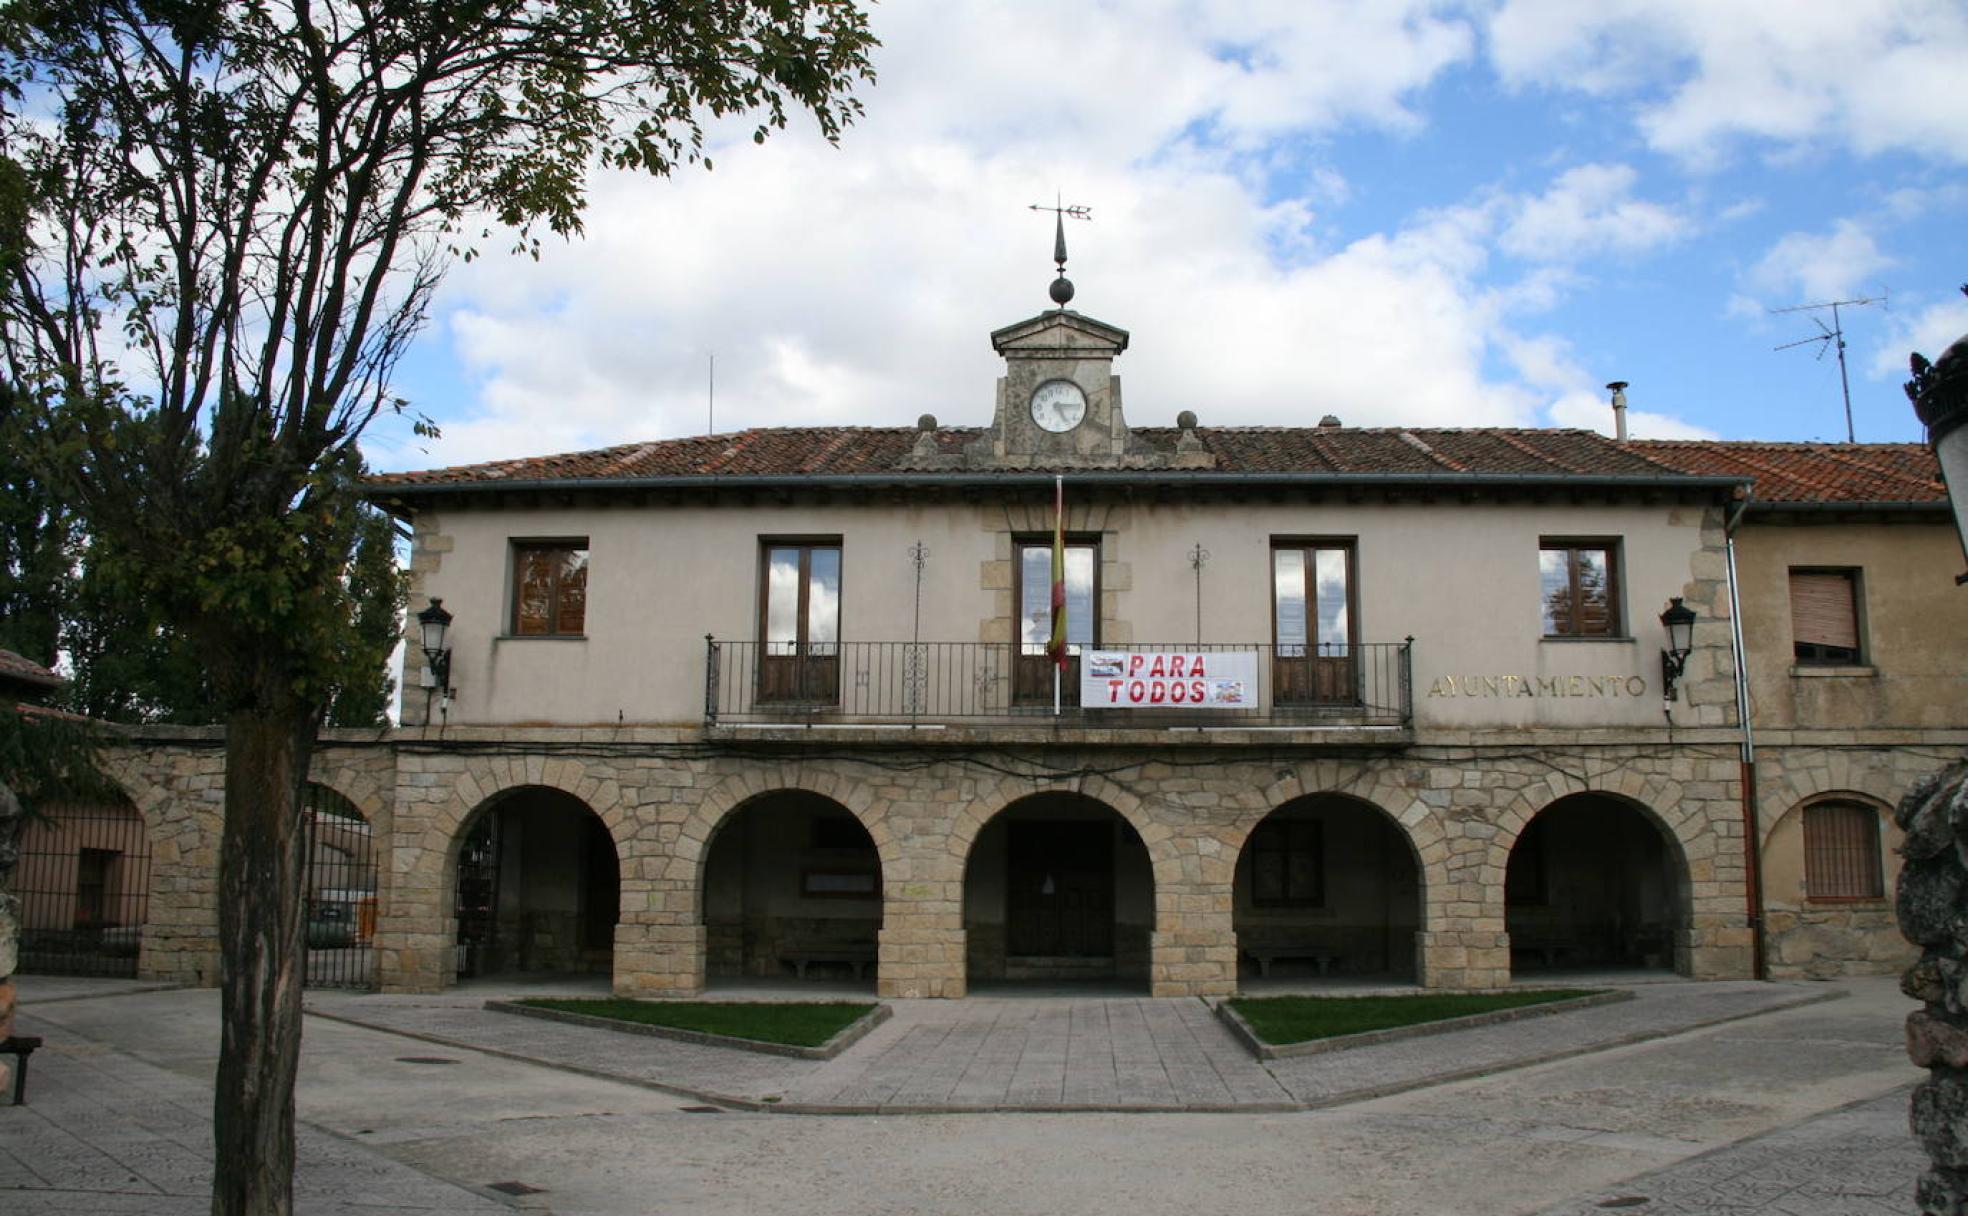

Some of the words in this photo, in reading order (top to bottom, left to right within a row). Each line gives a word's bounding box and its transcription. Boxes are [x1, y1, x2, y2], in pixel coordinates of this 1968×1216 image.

[1128, 655, 1206, 677] PARA
[1108, 680, 1205, 703] TODOS
[1427, 675, 1647, 698] AYUNTAMIENTO
